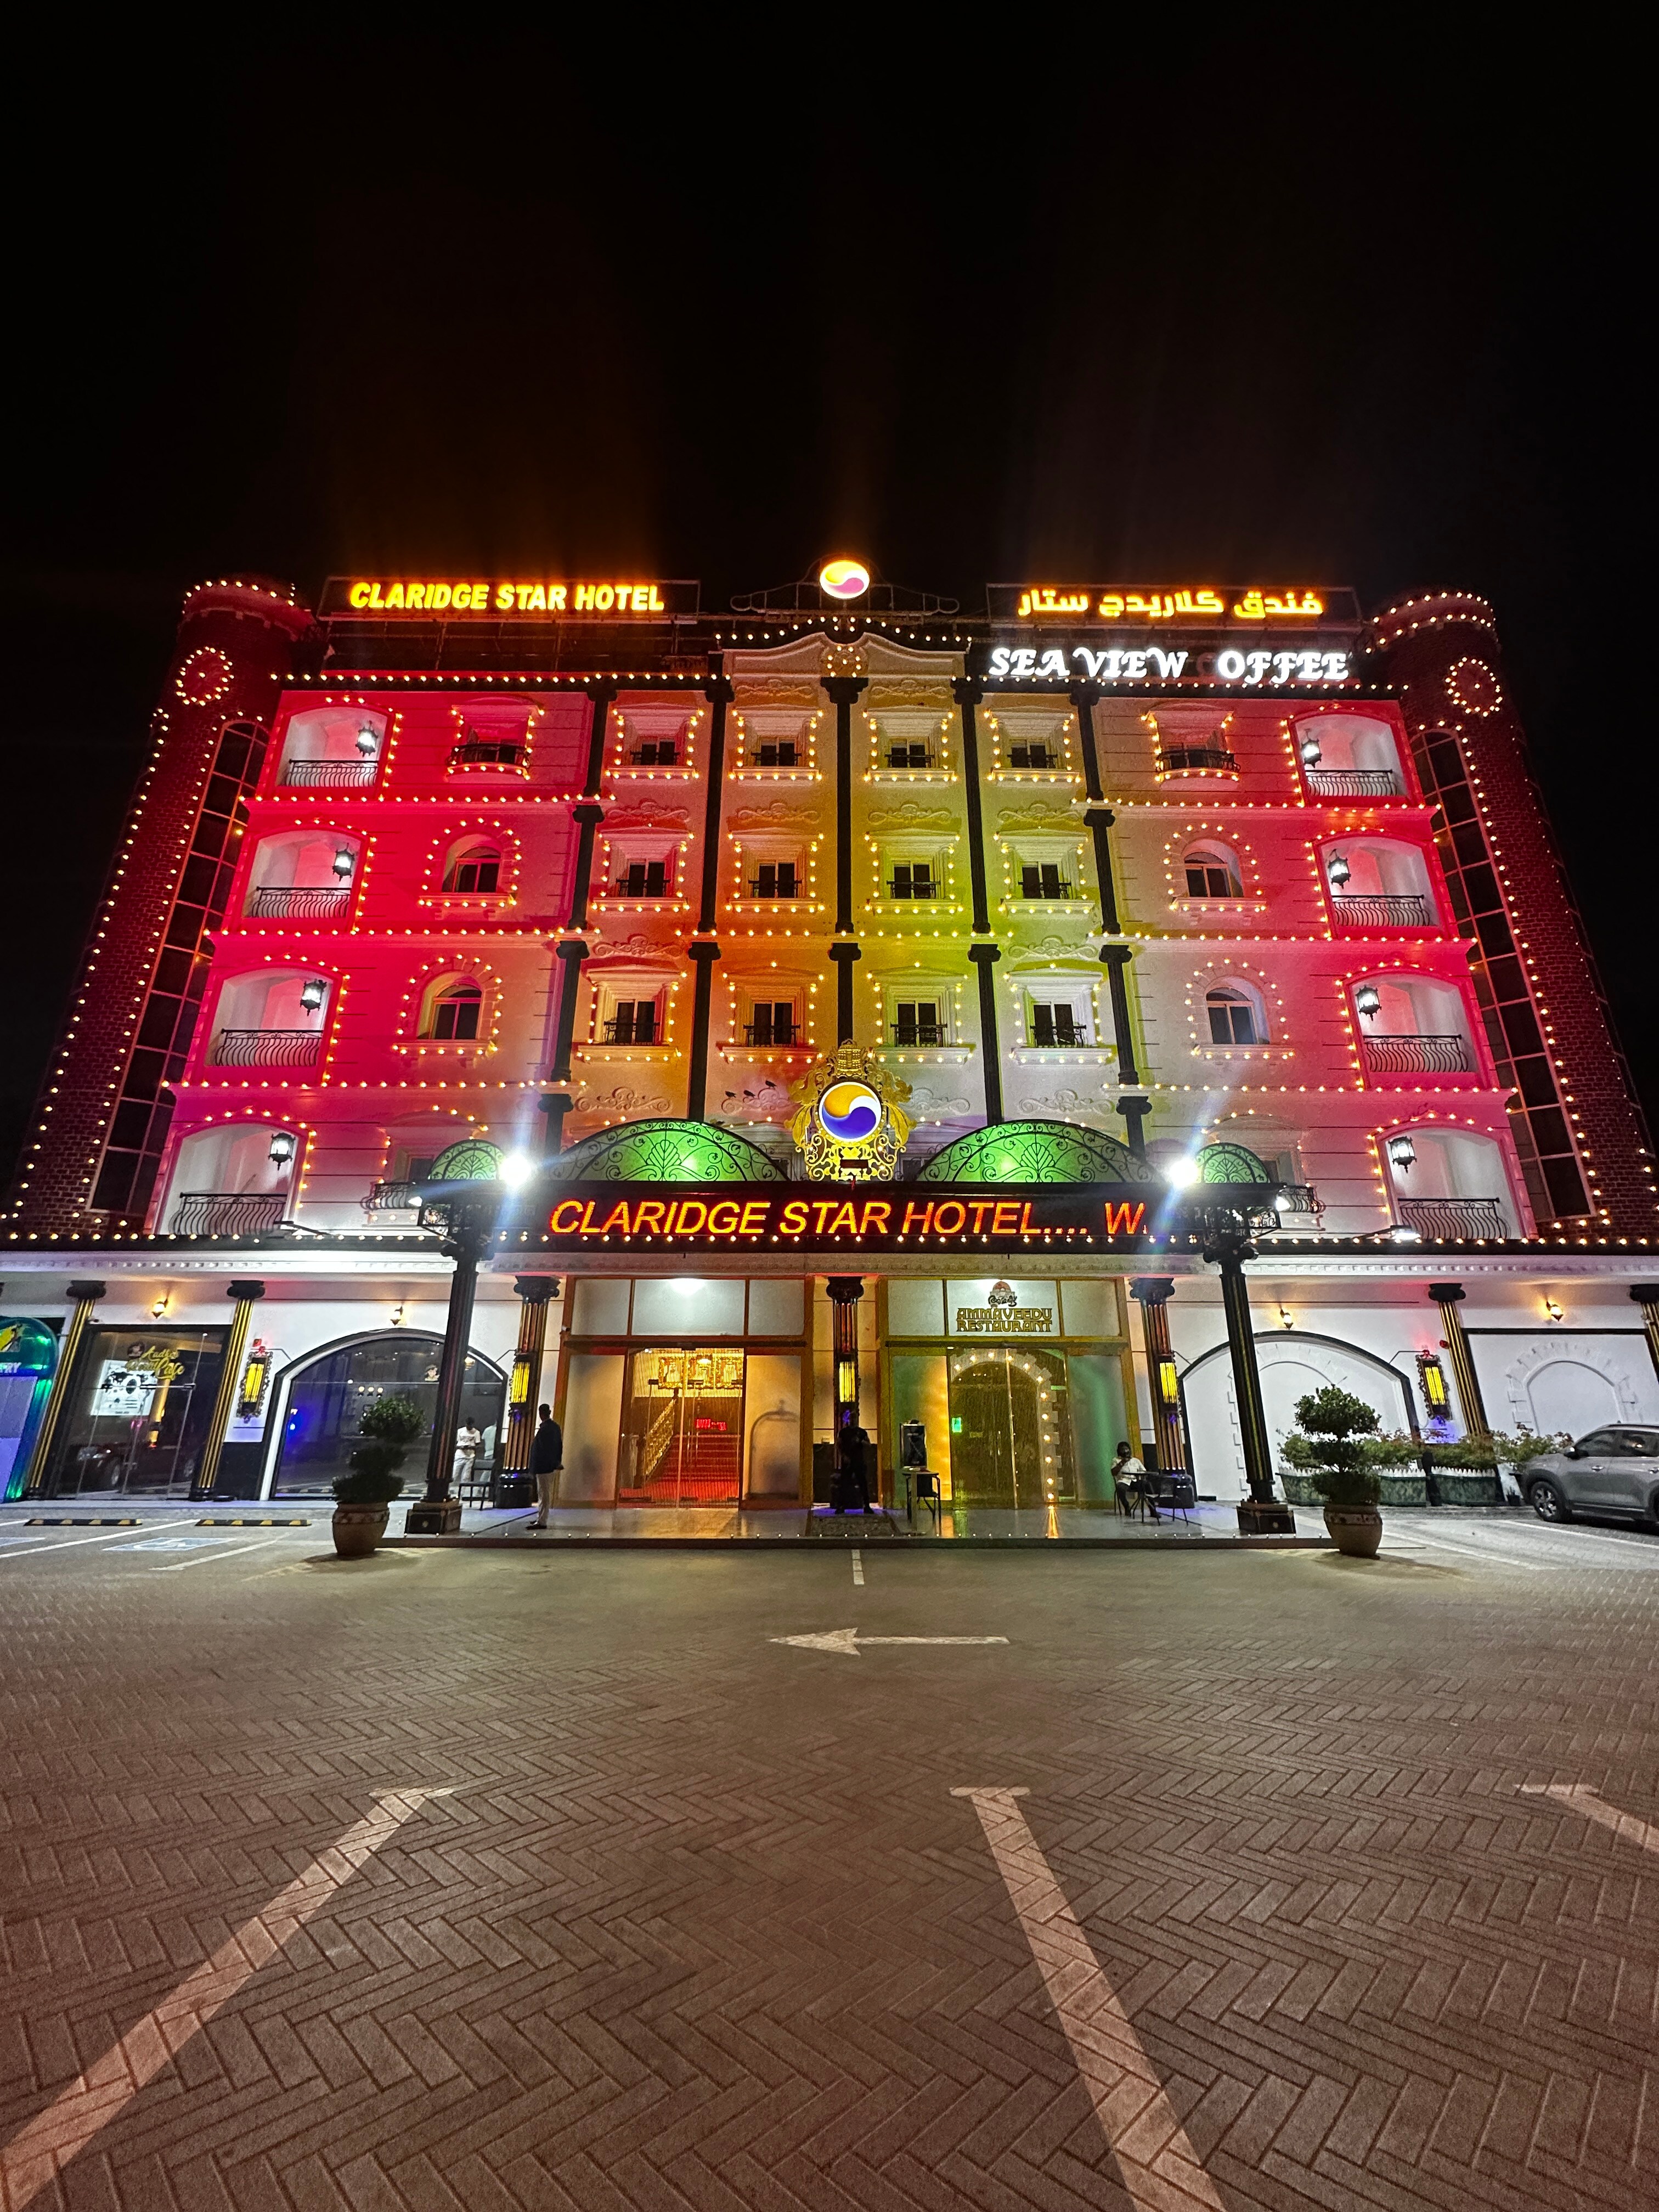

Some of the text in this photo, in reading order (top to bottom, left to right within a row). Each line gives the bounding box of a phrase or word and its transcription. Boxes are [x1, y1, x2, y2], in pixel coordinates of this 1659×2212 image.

[349, 582, 665, 612] CLARIDGE STAR HOTEL
[1018, 588, 1324, 619] فندق كلاريدج ستار
[988, 647, 1070, 679] SEA
[1073, 647, 1188, 679] VIEW
[549, 1199, 771, 1234] CLARIDGE
[778, 1200, 892, 1234] STAR
[1104, 1201, 1147, 1234] W
[956, 1320, 1053, 1332] RESTAURANT
[957, 1308, 1053, 1320] AMMAVEEDU
